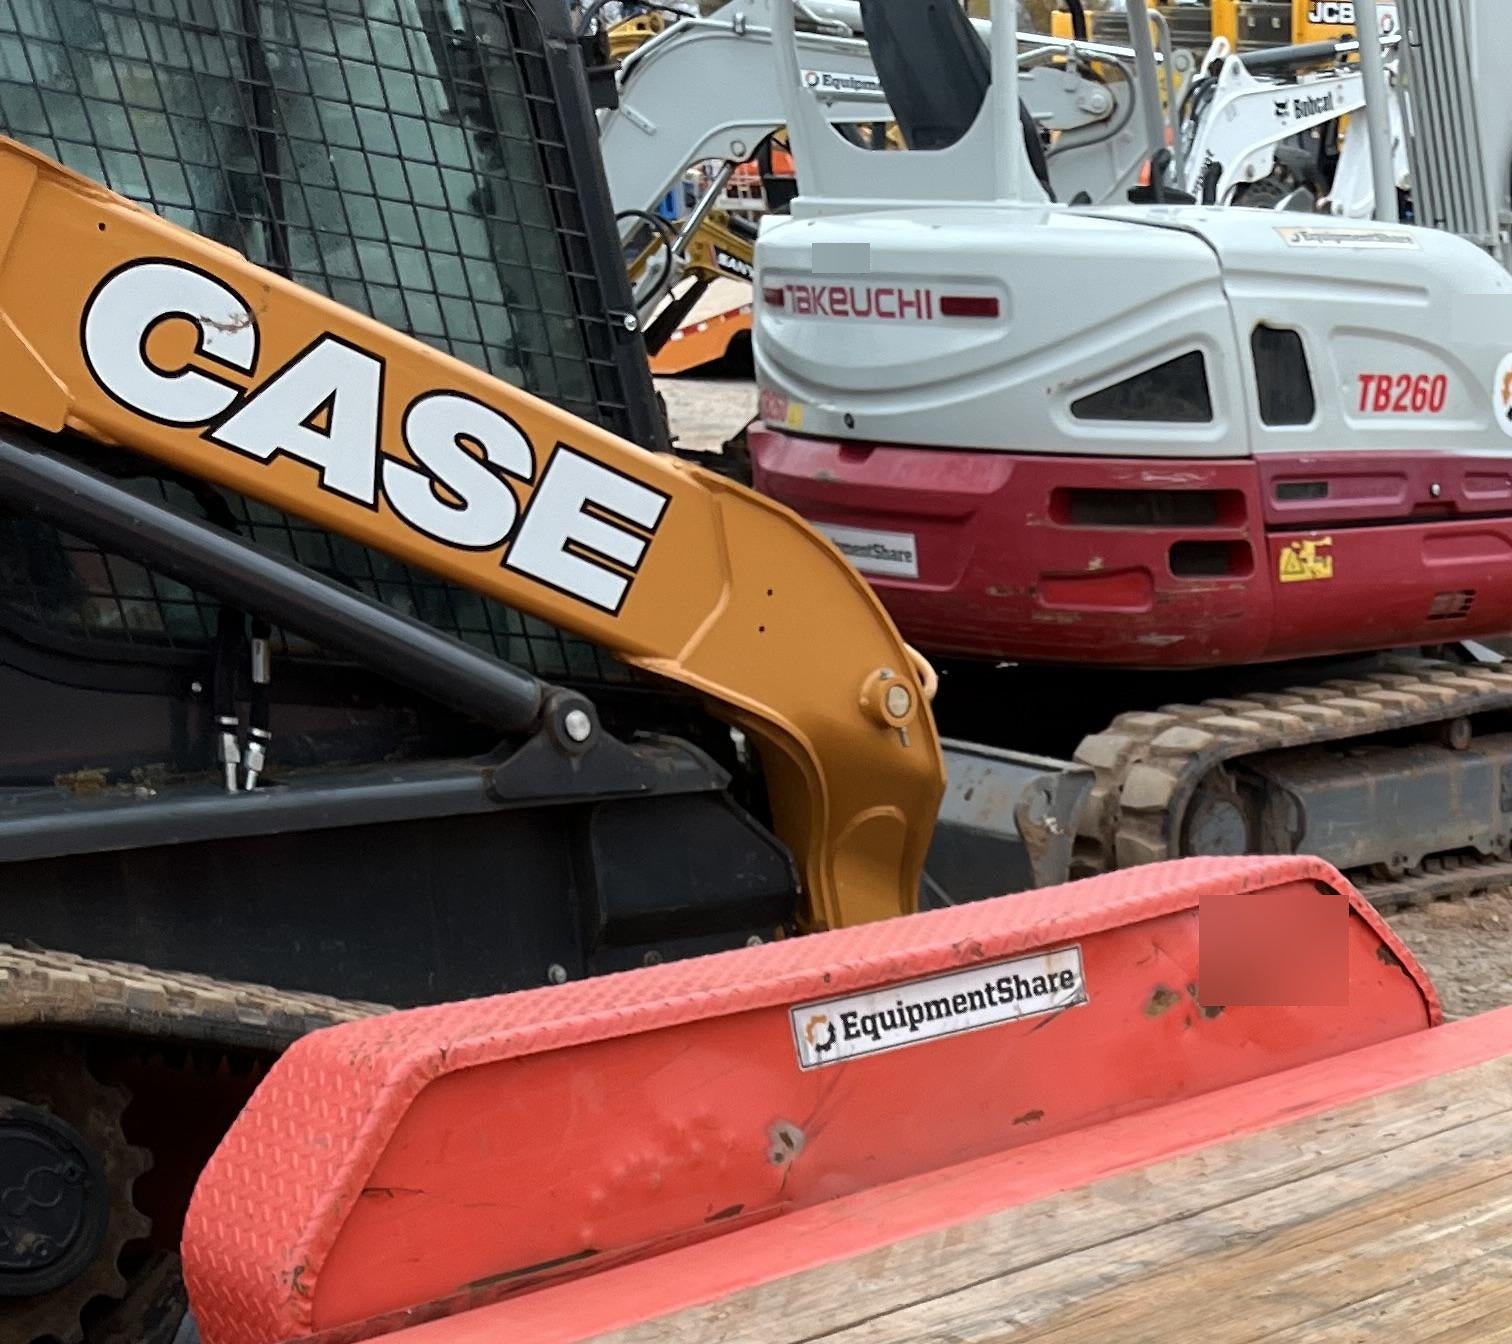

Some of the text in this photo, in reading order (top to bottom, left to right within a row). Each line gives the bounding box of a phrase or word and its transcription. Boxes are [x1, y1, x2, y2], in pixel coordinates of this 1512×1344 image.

[1308, 1, 1355, 24] JCB
[785, 284, 933, 320] TAKEUCHI
[1358, 373, 1449, 413] TB260
[82, 257, 672, 616] CASE
[840, 967, 1075, 1042] EquipmentShare
